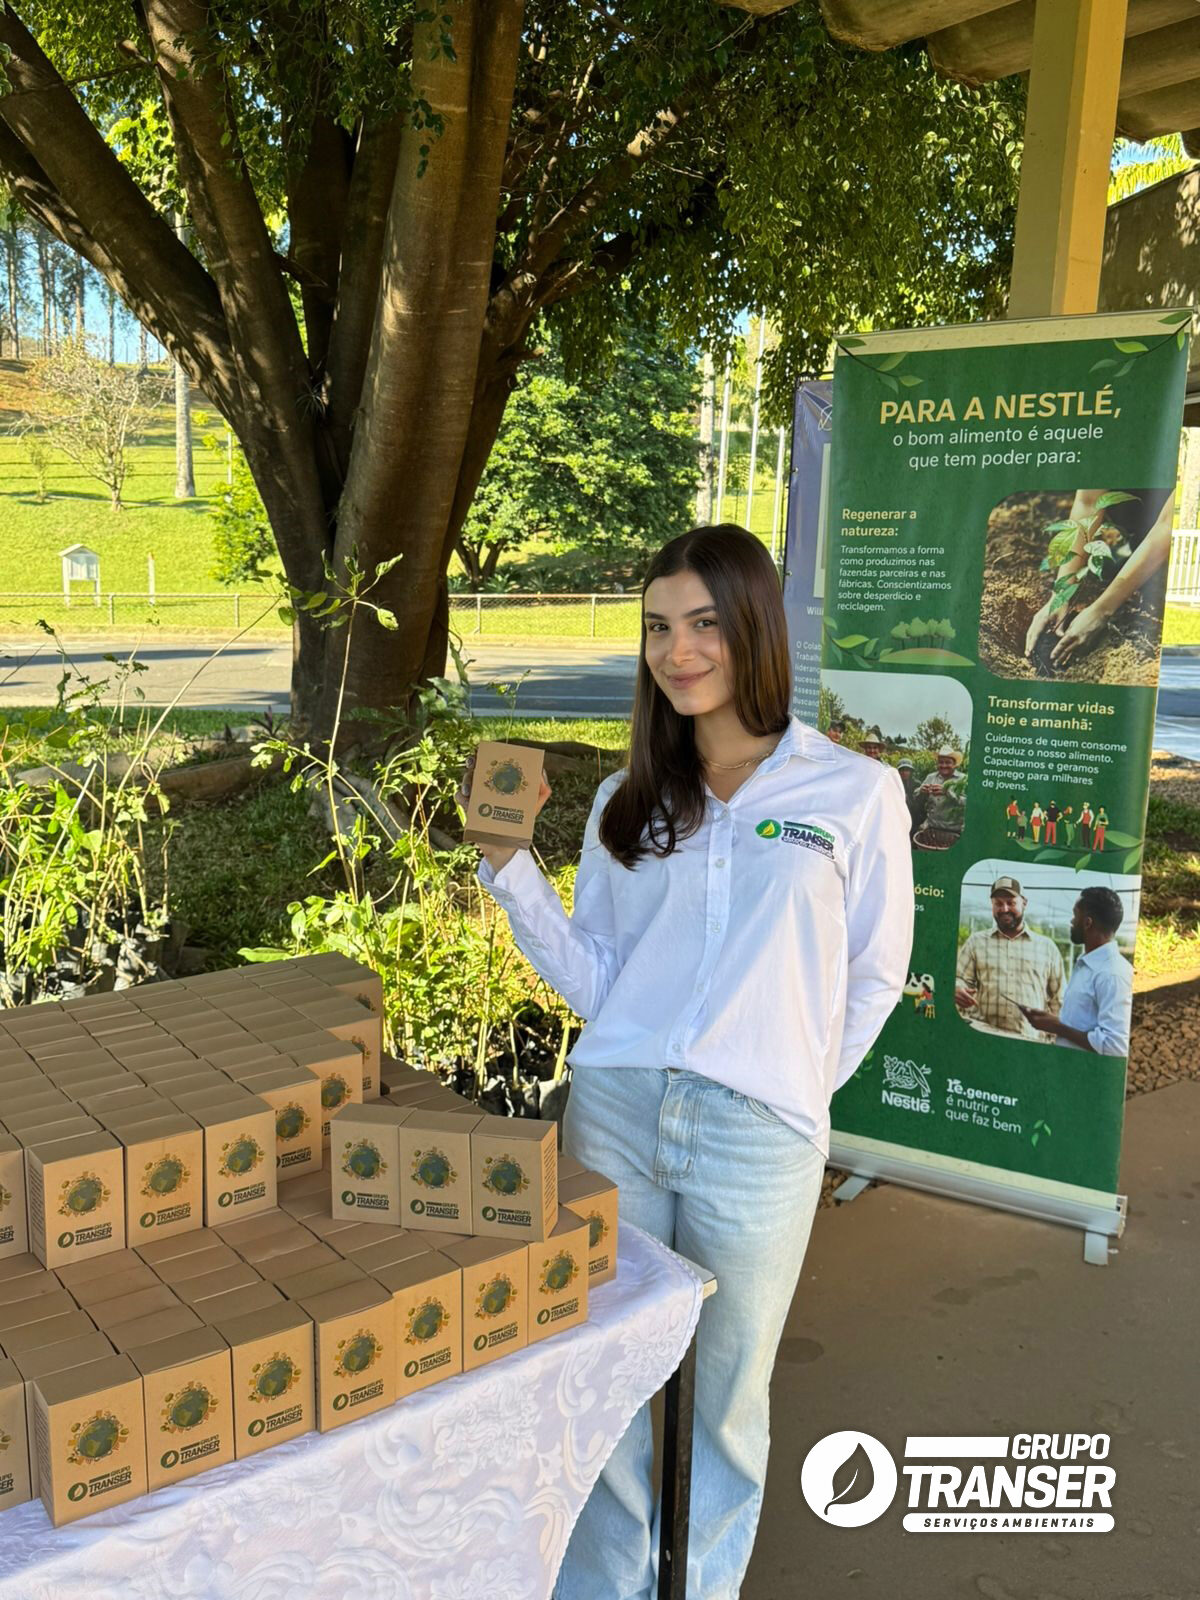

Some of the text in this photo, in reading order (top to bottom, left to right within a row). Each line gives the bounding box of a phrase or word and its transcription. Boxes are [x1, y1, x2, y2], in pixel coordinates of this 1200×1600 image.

[880, 384, 1121, 425] PARA A NESTLÉ,
[893, 424, 1104, 446] o bom alimento é aquele
[909, 450, 1081, 471] que tem poder para:
[842, 508, 917, 522] Regenerar a
[841, 525, 899, 537] natureza:
[841, 546, 907, 555] Transformamos
[917, 546, 945, 555] forma
[840, 558, 935, 568] como produzimos nas
[839, 568, 877, 579] fazendas
[879, 569, 919, 579] parceiras
[839, 579, 952, 590] fábricas. Conscientizamos
[838, 590, 861, 601] sobre
[864, 591, 913, 602] desperdício
[837, 601, 885, 612] reciclagem.
[988, 696, 1115, 715] Transformar vidas
[987, 712, 1093, 731] hoje e amanhã:
[985, 733, 1127, 752] Cuidamos de quem consome
[993, 745, 1025, 757] produz
[1037, 749, 1065, 759] nosso
[1068, 751, 1114, 763] alimento.
[984, 756, 1045, 771] Capacitamos
[1057, 763, 1099, 775] geramos
[983, 769, 1093, 785] emprego para milhares
[982, 779, 1029, 792] de jovens.
[493, 810, 524, 821] TRANSER
[783, 828, 834, 852] TRANSER
[946, 1094, 999, 1116] é nutrir o
[945, 1110, 1021, 1134] que faz bem
[281, 1150, 311, 1164] TRANSER
[233, 1186, 266, 1201] TRANSER
[357, 1197, 389, 1207] TRANSER
[156, 1207, 191, 1221] TRANSER
[426, 1206, 459, 1216] TRANSER
[498, 1213, 532, 1222] TRANSER
[75, 1227, 112, 1240] TRANSER
[551, 1302, 578, 1319] TRANSER
[488, 1326, 518, 1343] TRANSER
[420, 1352, 451, 1370] TRANSER
[350, 1384, 384, 1403] TRANSER
[266, 1409, 302, 1428] TRANSER
[180, 1440, 220, 1460] TRANSER
[89, 1471, 132, 1492] TRANSER
